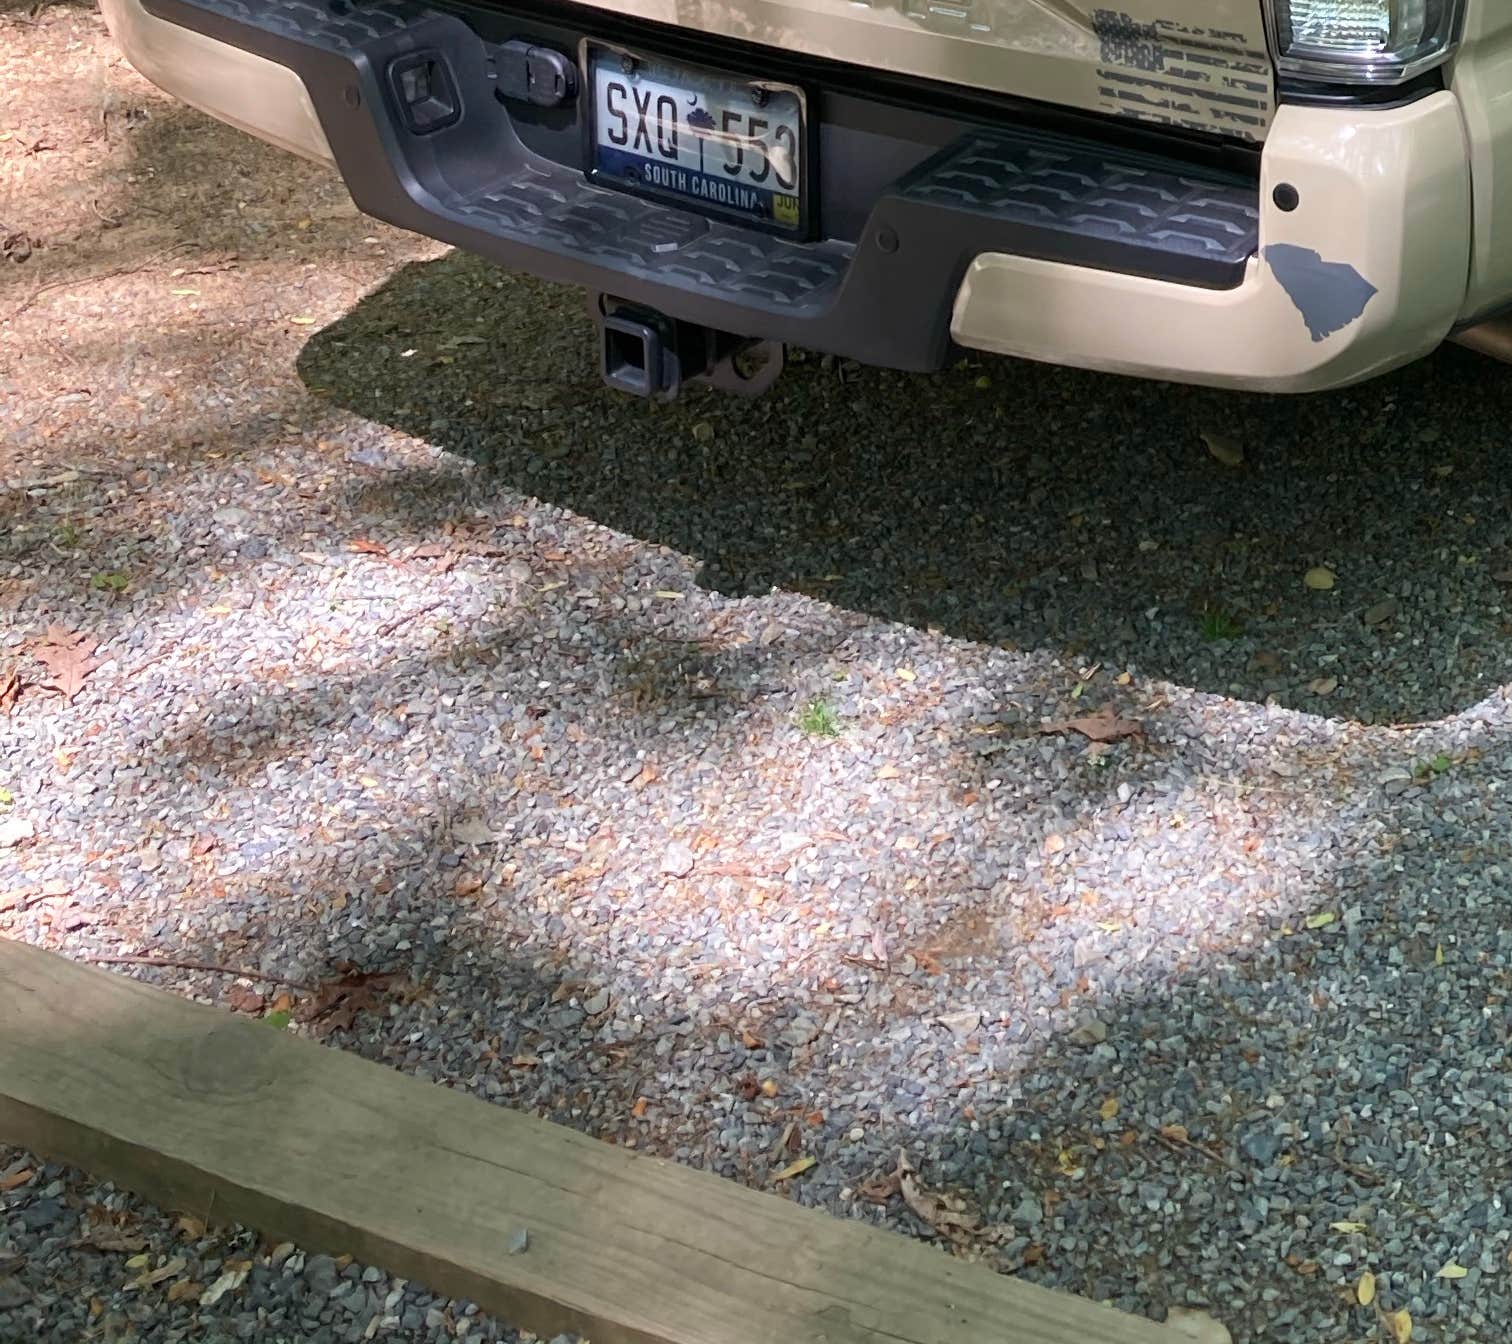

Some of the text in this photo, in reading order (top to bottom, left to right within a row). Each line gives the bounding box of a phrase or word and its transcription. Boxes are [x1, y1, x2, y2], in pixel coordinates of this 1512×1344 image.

[607, 82, 679, 161] SXQ
[644, 163, 764, 209] SOUTH CAROLINA
